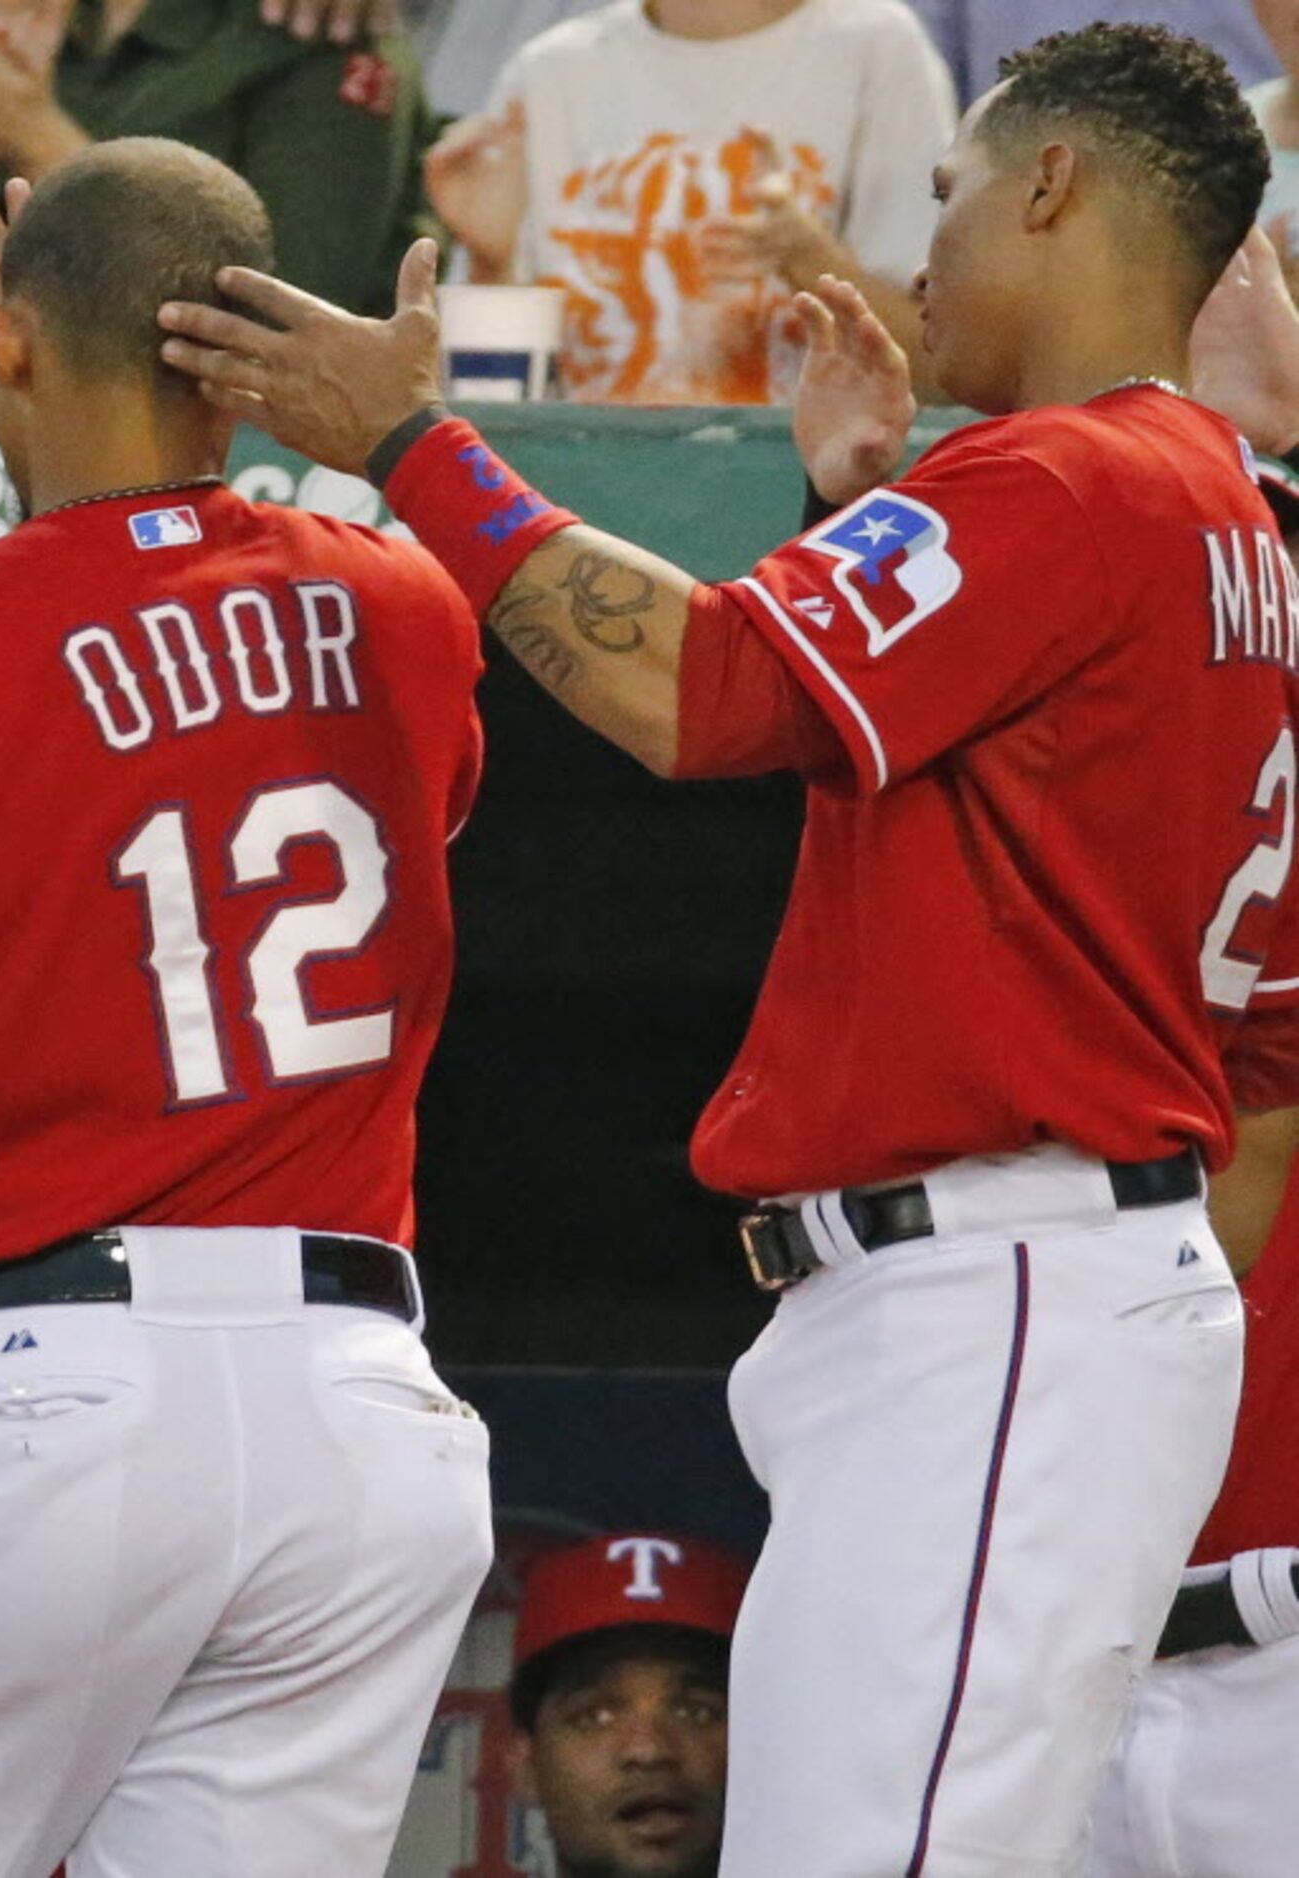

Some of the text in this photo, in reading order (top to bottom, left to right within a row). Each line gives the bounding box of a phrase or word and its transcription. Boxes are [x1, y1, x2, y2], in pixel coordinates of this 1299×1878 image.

[62, 580, 362, 752] ODOR
[113, 776, 395, 1108] 12
[606, 1537, 681, 1600] T
